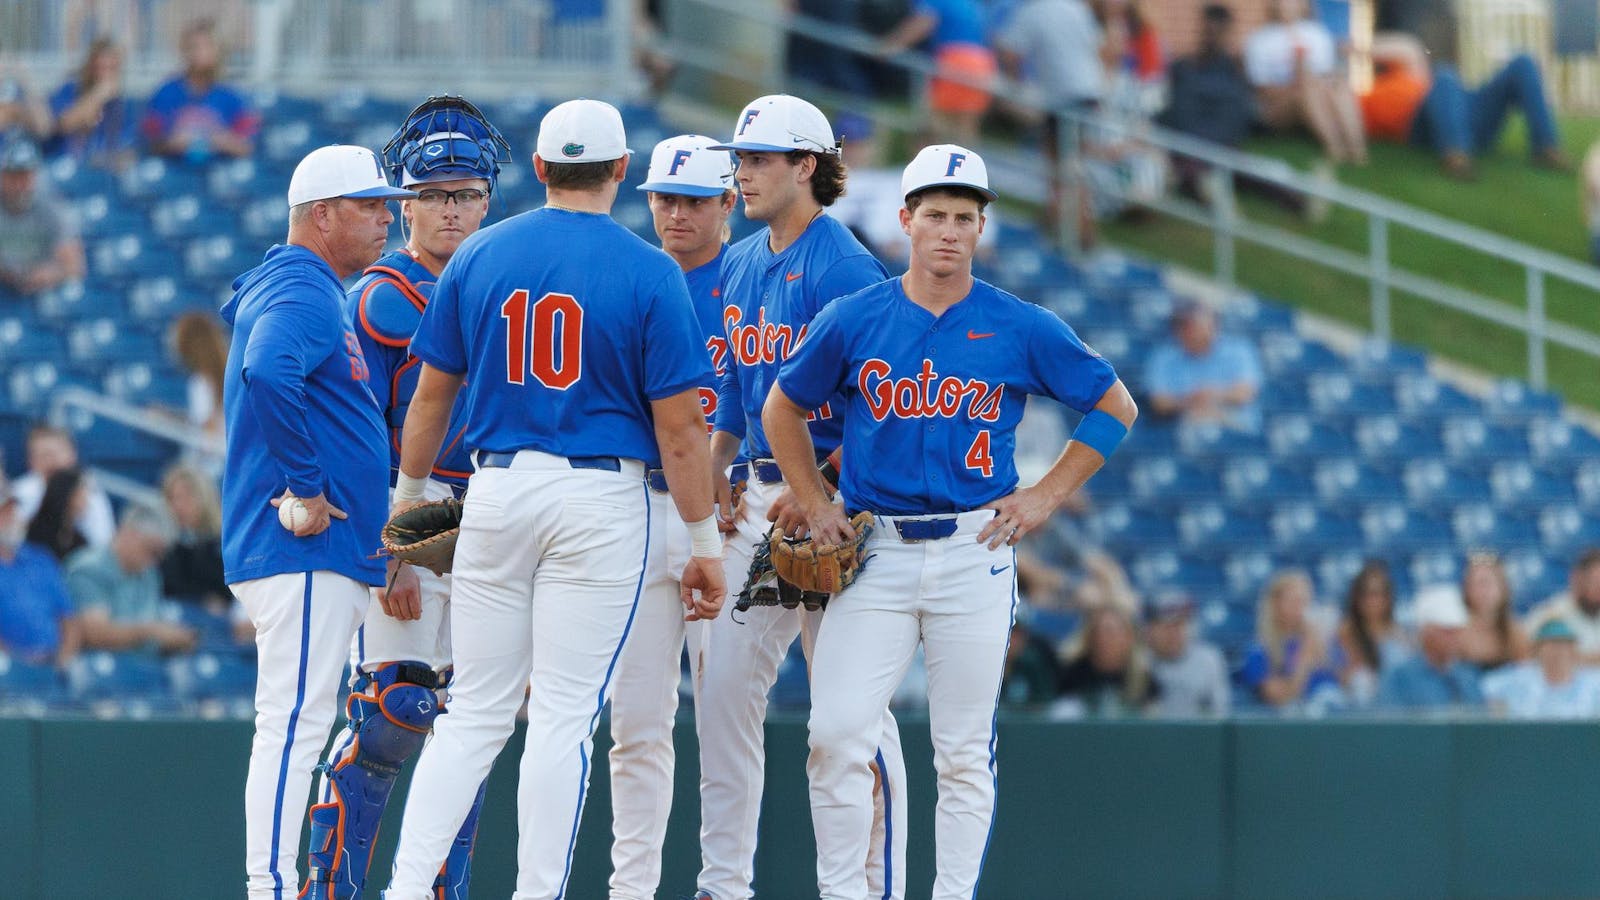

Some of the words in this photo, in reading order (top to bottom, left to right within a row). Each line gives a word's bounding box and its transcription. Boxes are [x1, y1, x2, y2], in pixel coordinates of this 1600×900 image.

[739, 109, 760, 136] F
[667, 149, 692, 176] F
[944, 152, 966, 177] F
[501, 288, 584, 391] 10
[858, 358, 1005, 422] Gators
[964, 429, 994, 478] 4
